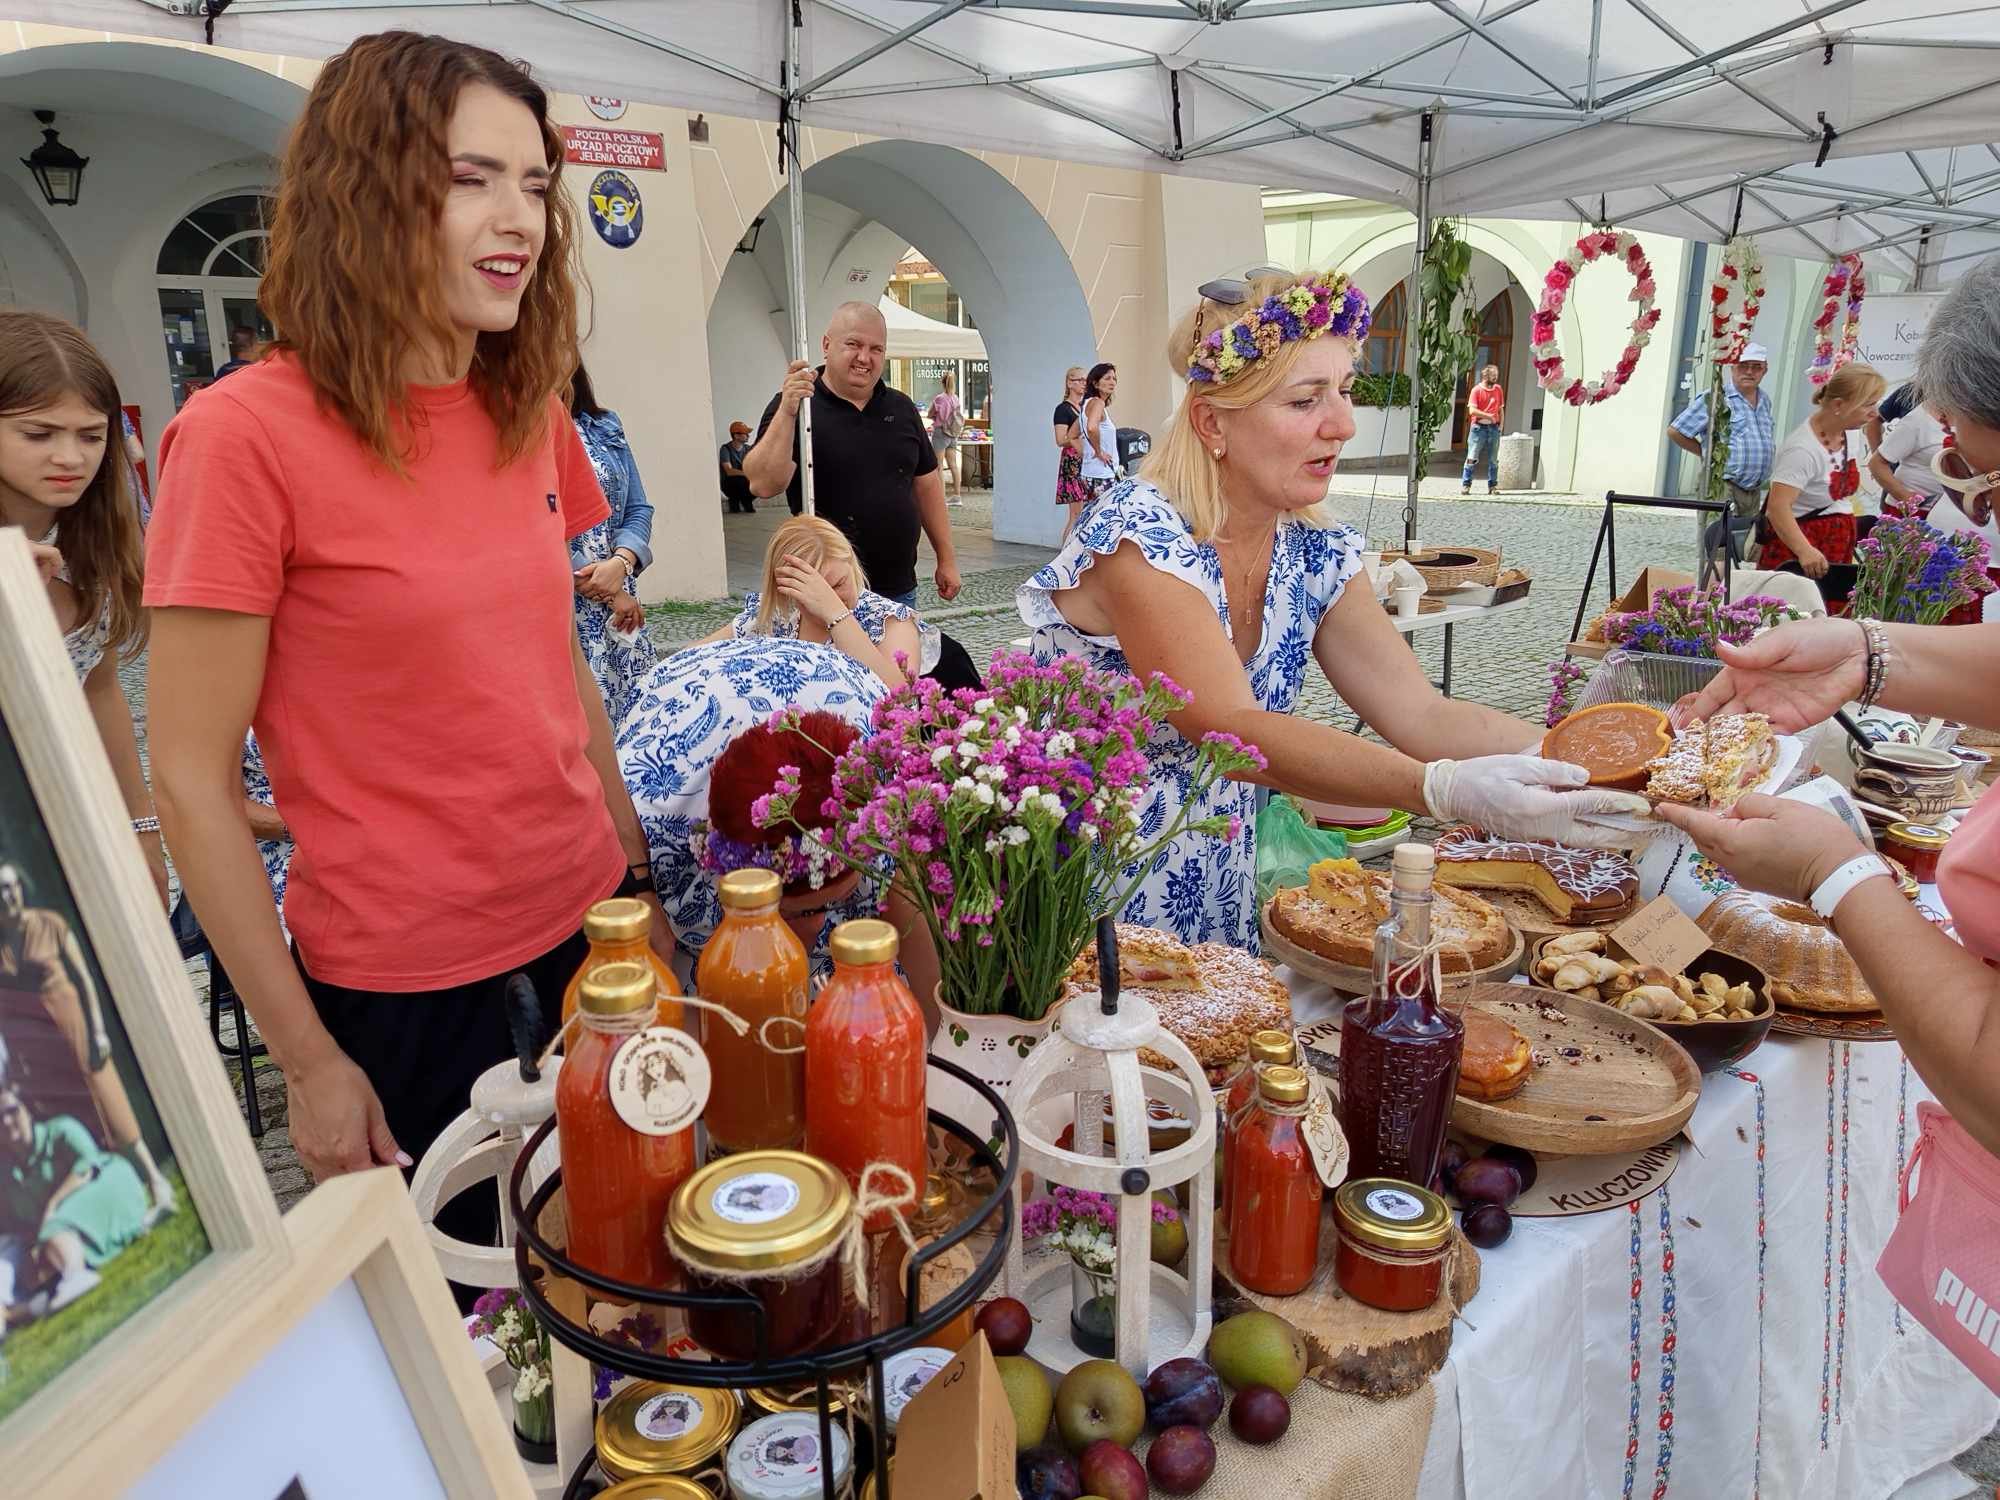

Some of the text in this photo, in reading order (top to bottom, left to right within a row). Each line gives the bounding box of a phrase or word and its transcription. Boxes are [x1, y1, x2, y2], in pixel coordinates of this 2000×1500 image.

[576, 130, 649, 145] POCZTA POLSKA
[605, 143, 659, 157] POCZTOWY
[579, 152, 615, 163] JELENIA
[644, 156, 650, 166] 7
[1895, 322, 1920, 344] Kob
